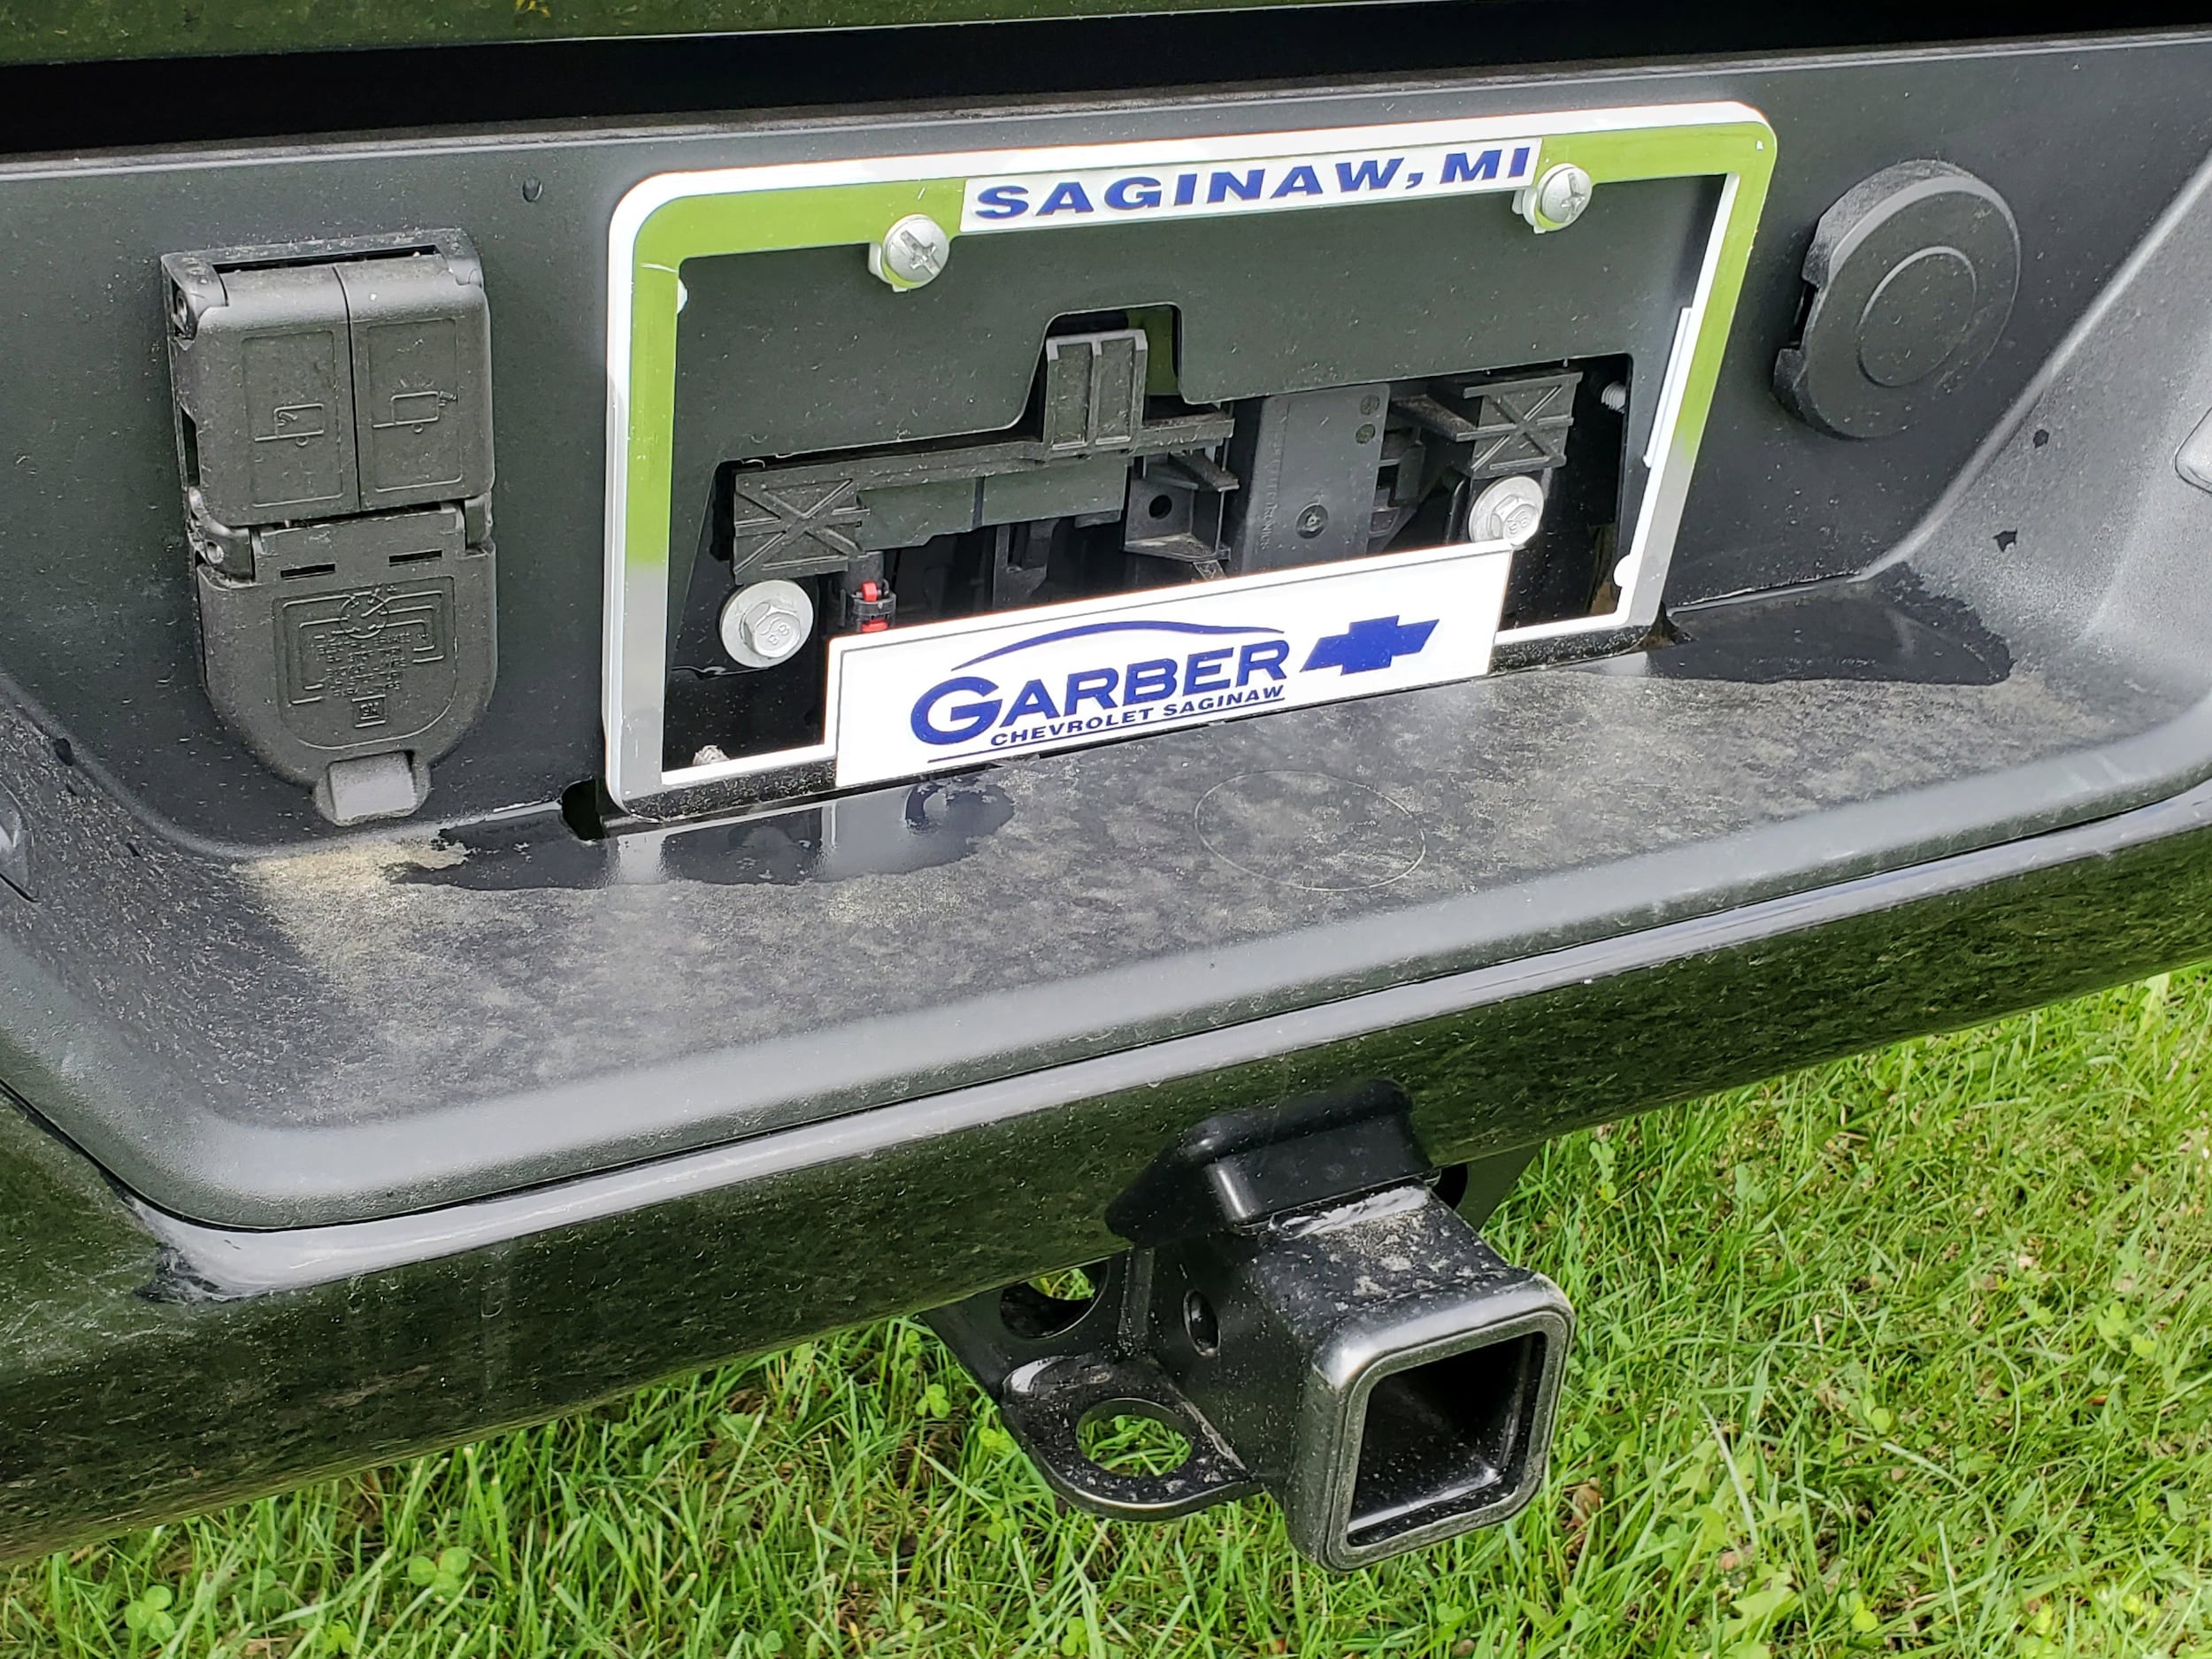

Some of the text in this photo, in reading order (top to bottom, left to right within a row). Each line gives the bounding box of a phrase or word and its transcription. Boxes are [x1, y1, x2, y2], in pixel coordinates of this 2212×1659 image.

[975, 147, 1531, 219] SAGINAW, MI
[910, 639, 1290, 745] GARBER
[990, 684, 1285, 747] CHEVROLET SAGINAW
